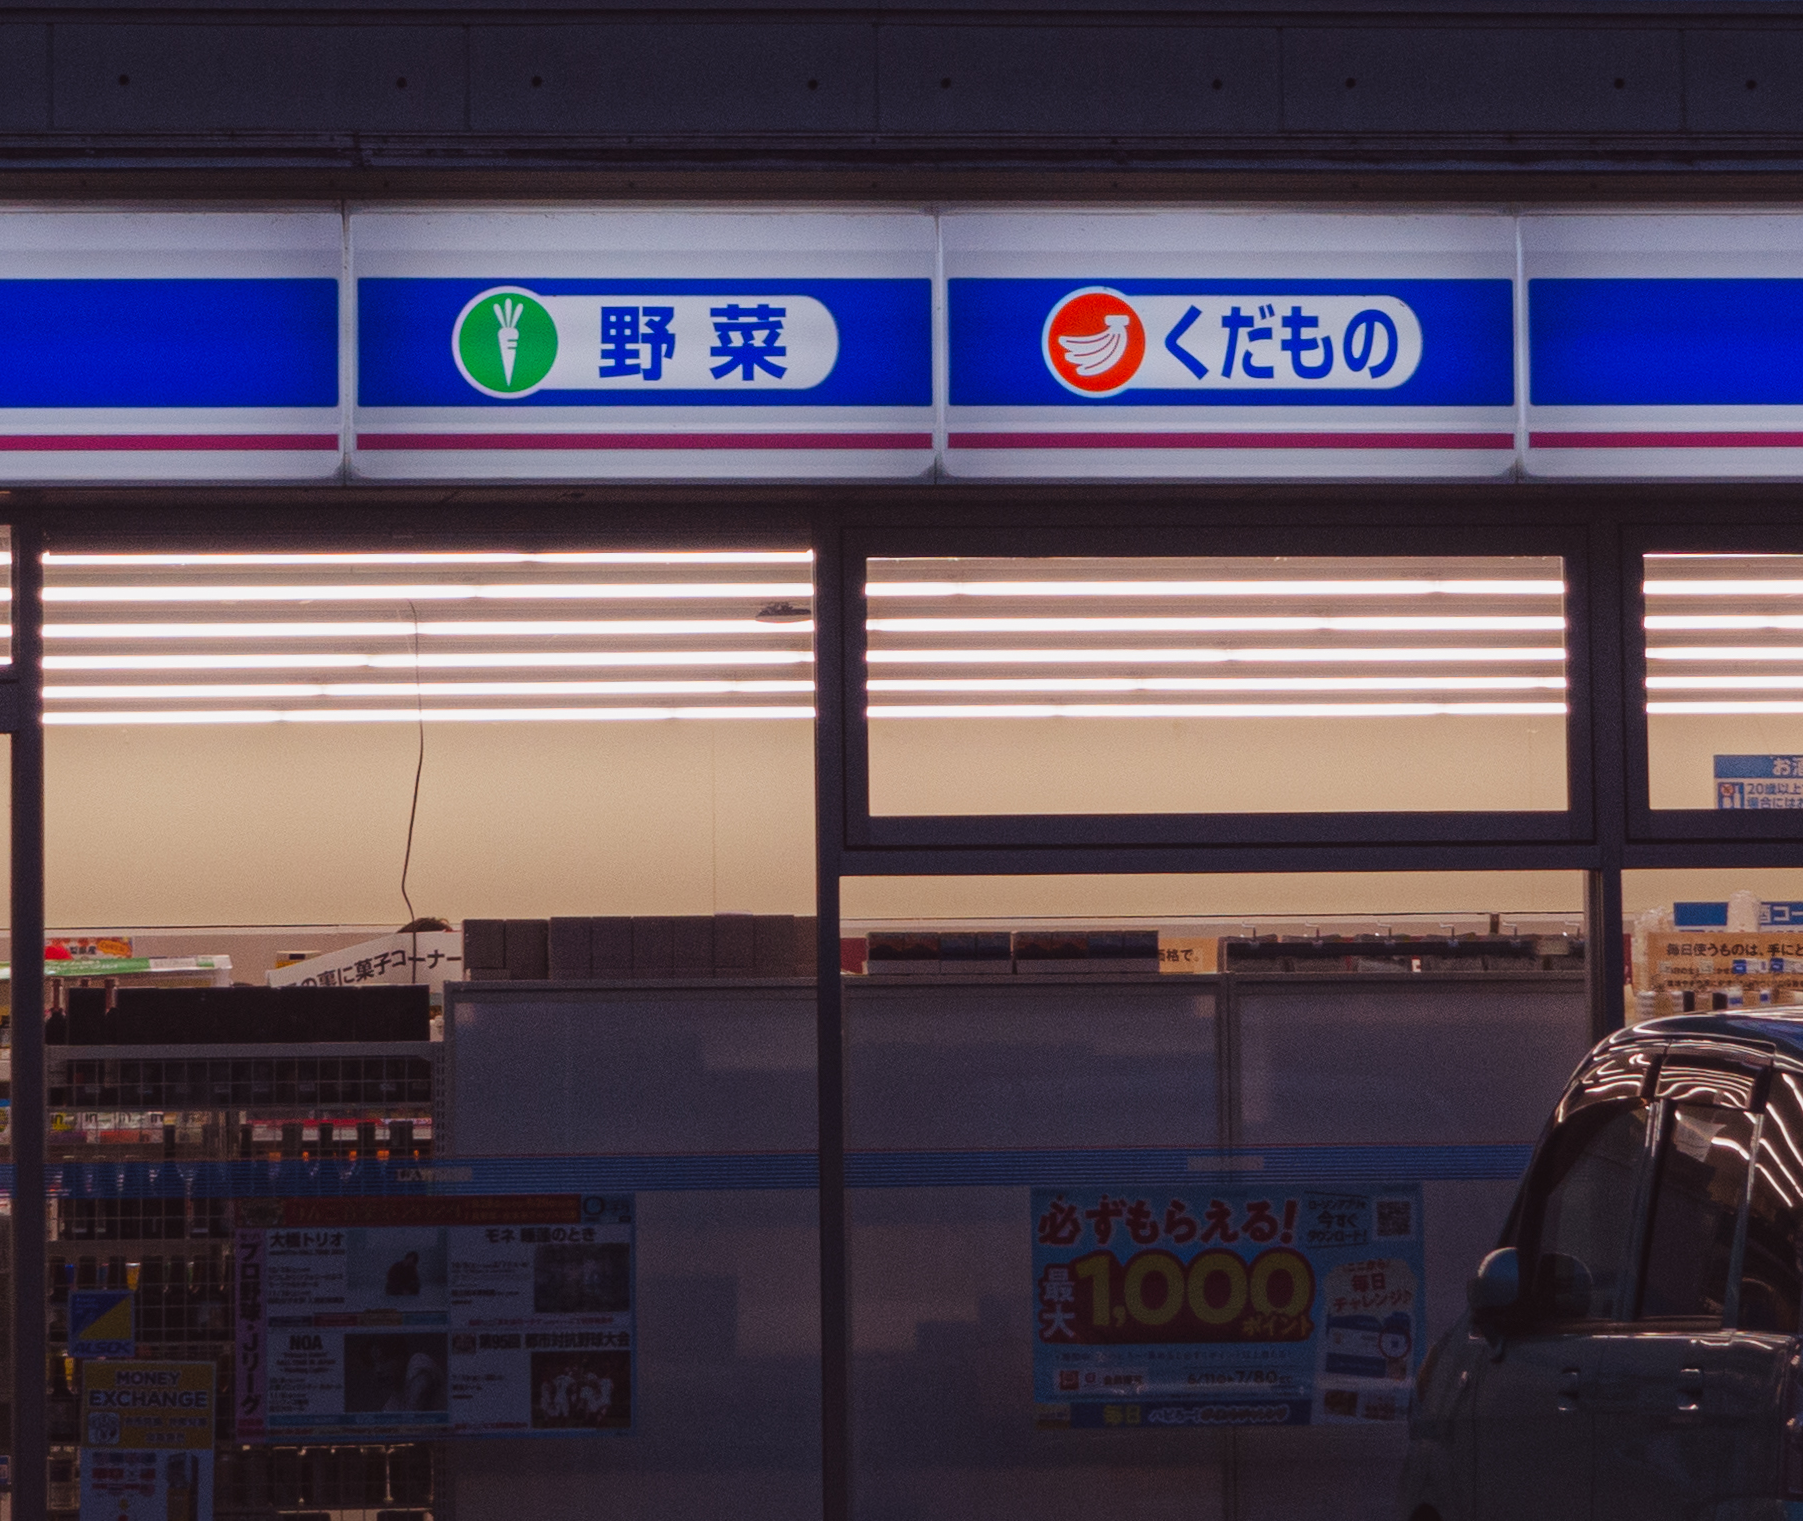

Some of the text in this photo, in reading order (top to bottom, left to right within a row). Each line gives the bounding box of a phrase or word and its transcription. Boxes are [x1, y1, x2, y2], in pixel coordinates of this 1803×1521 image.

[599, 304, 787, 381] 野菜
[1165, 304, 1398, 379] くだもの
[290, 949, 462, 986] の裏に菓子コーナー
[1037, 1195, 1298, 1246] 必ずもらえる!
[1317, 1211, 1358, 1229] 今すぐ
[1074, 1252, 1312, 1328] 1,000
[1351, 1272, 1386, 1293] 毎日
[1042, 1267, 1076, 1339] 最大
[1242, 1313, 1313, 1338] ポイント
[289, 1335, 324, 1351] NOA
[116, 1371, 181, 1386] MONEY
[89, 1390, 208, 1408] EXCHANGE
